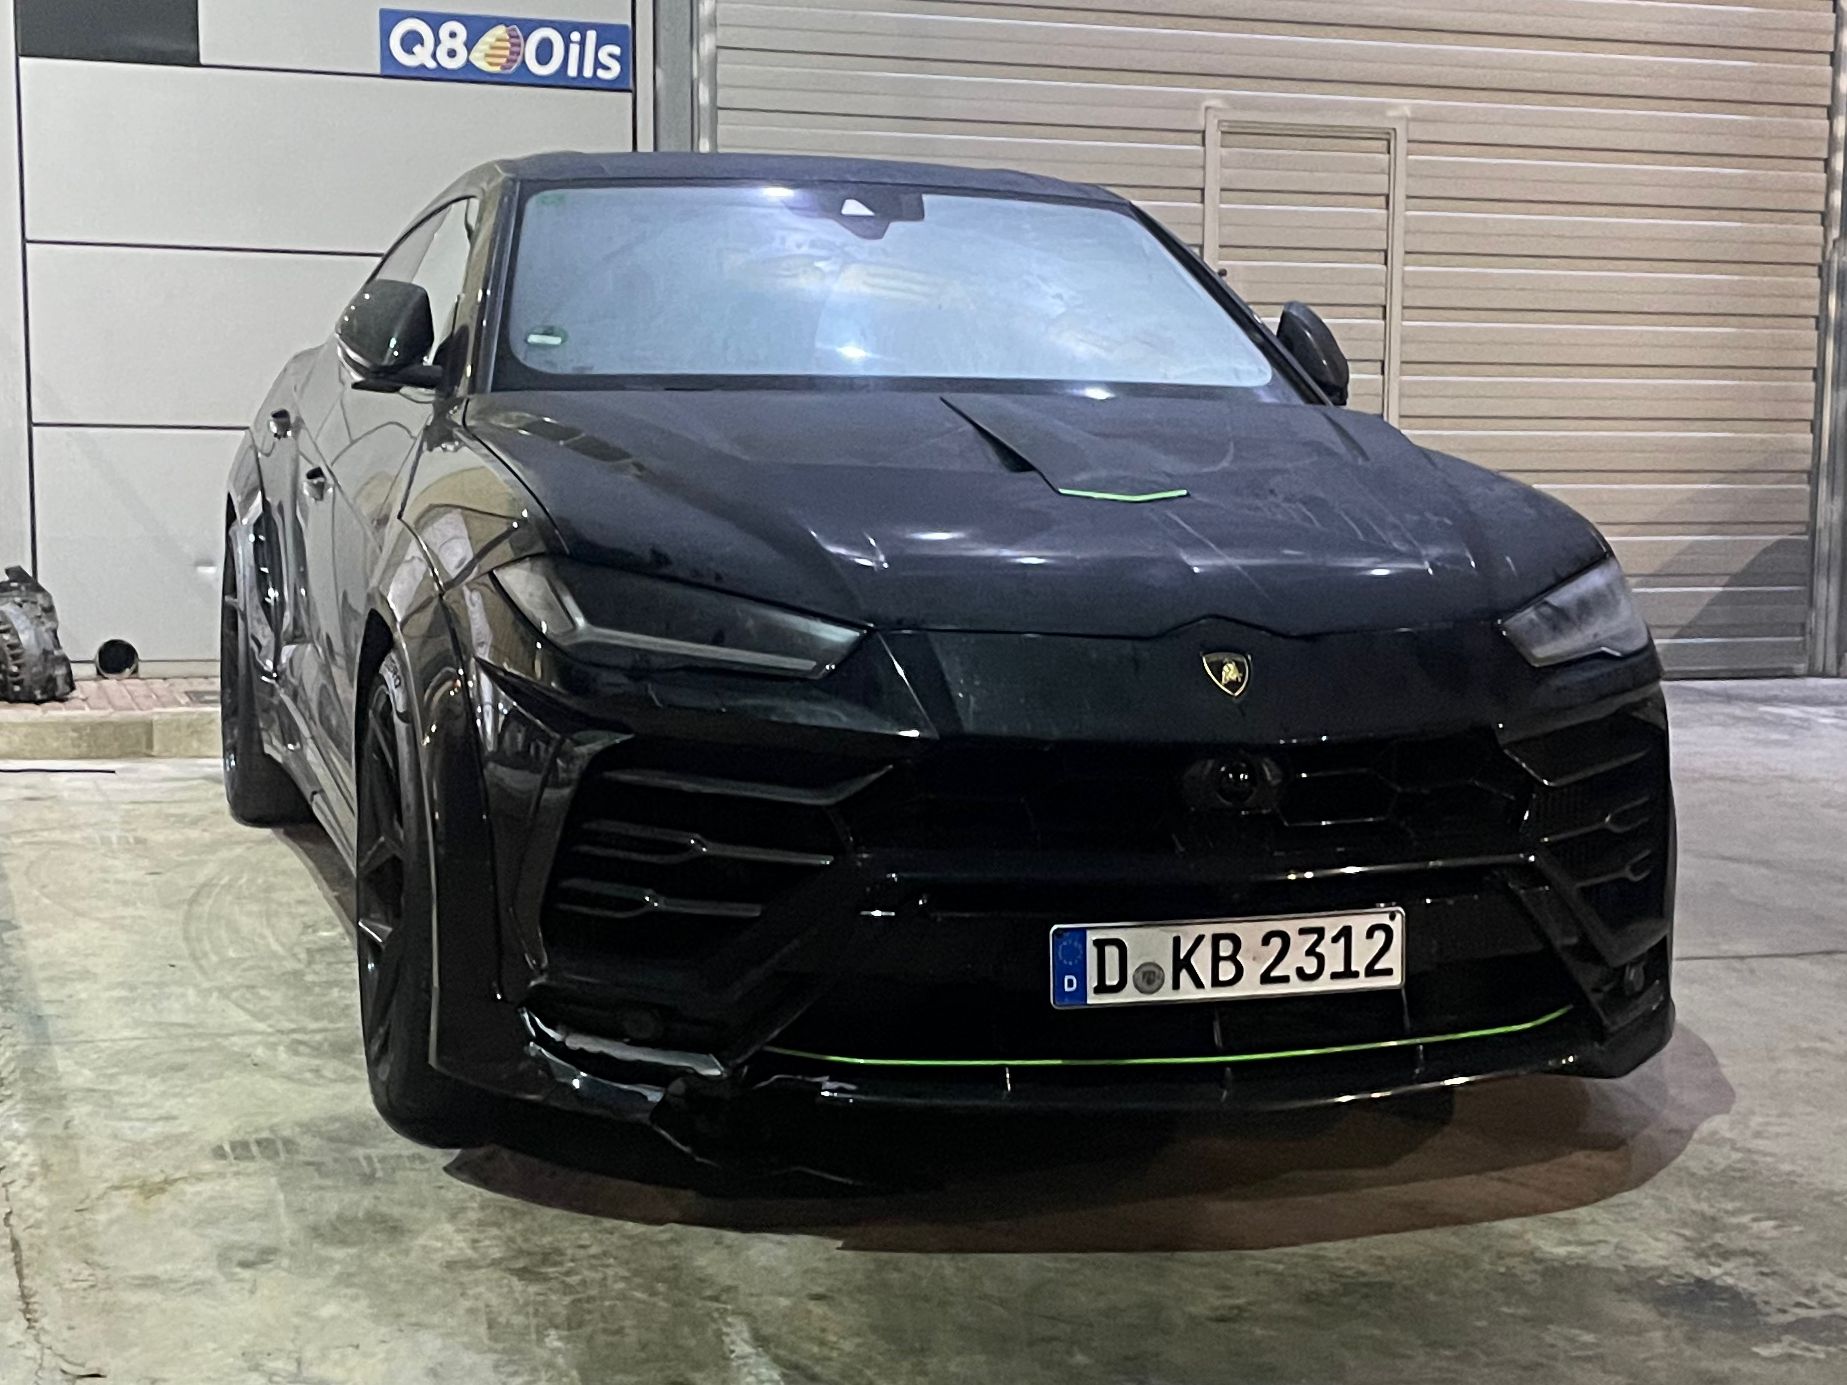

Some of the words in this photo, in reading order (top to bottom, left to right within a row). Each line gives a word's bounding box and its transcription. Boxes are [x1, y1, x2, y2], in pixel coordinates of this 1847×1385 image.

[389, 17, 468, 70] Q8
[524, 26, 622, 80] Oils
[1063, 975, 1077, 992] D
[1092, 937, 1128, 995] D
[1172, 932, 1244, 991] KB
[1259, 923, 1394, 985] 2312
